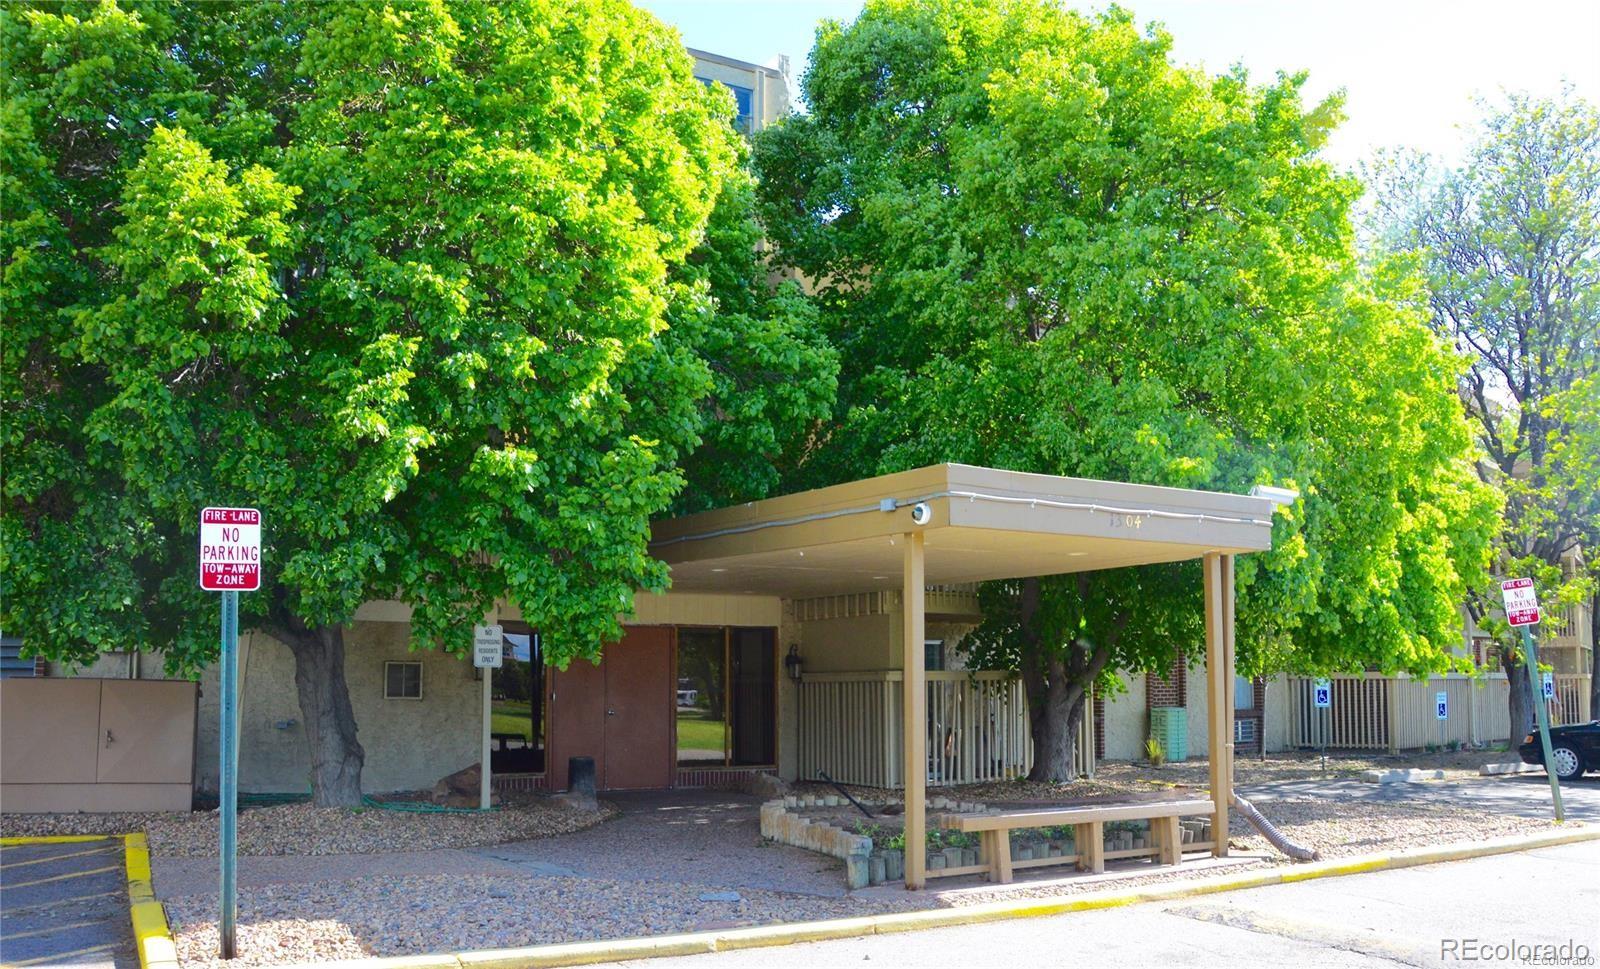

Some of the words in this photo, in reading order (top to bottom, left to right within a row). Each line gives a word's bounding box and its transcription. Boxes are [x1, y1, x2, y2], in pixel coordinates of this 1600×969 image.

[205, 511, 227, 521] FIRE
[232, 511, 257, 522] LANE
[222, 527, 240, 543] NO
[203, 545, 258, 561] PARKING
[204, 563, 257, 574] TOW-AWAY
[216, 574, 245, 585] ZONE
[1514, 589, 1525, 600] NO
[1506, 599, 1536, 611] PARKING
[1509, 608, 1537, 617] TOW-AWAY
[1516, 615, 1533, 623] ZONE
[484, 628, 493, 636] NO
[481, 655, 495, 663] ONLY
